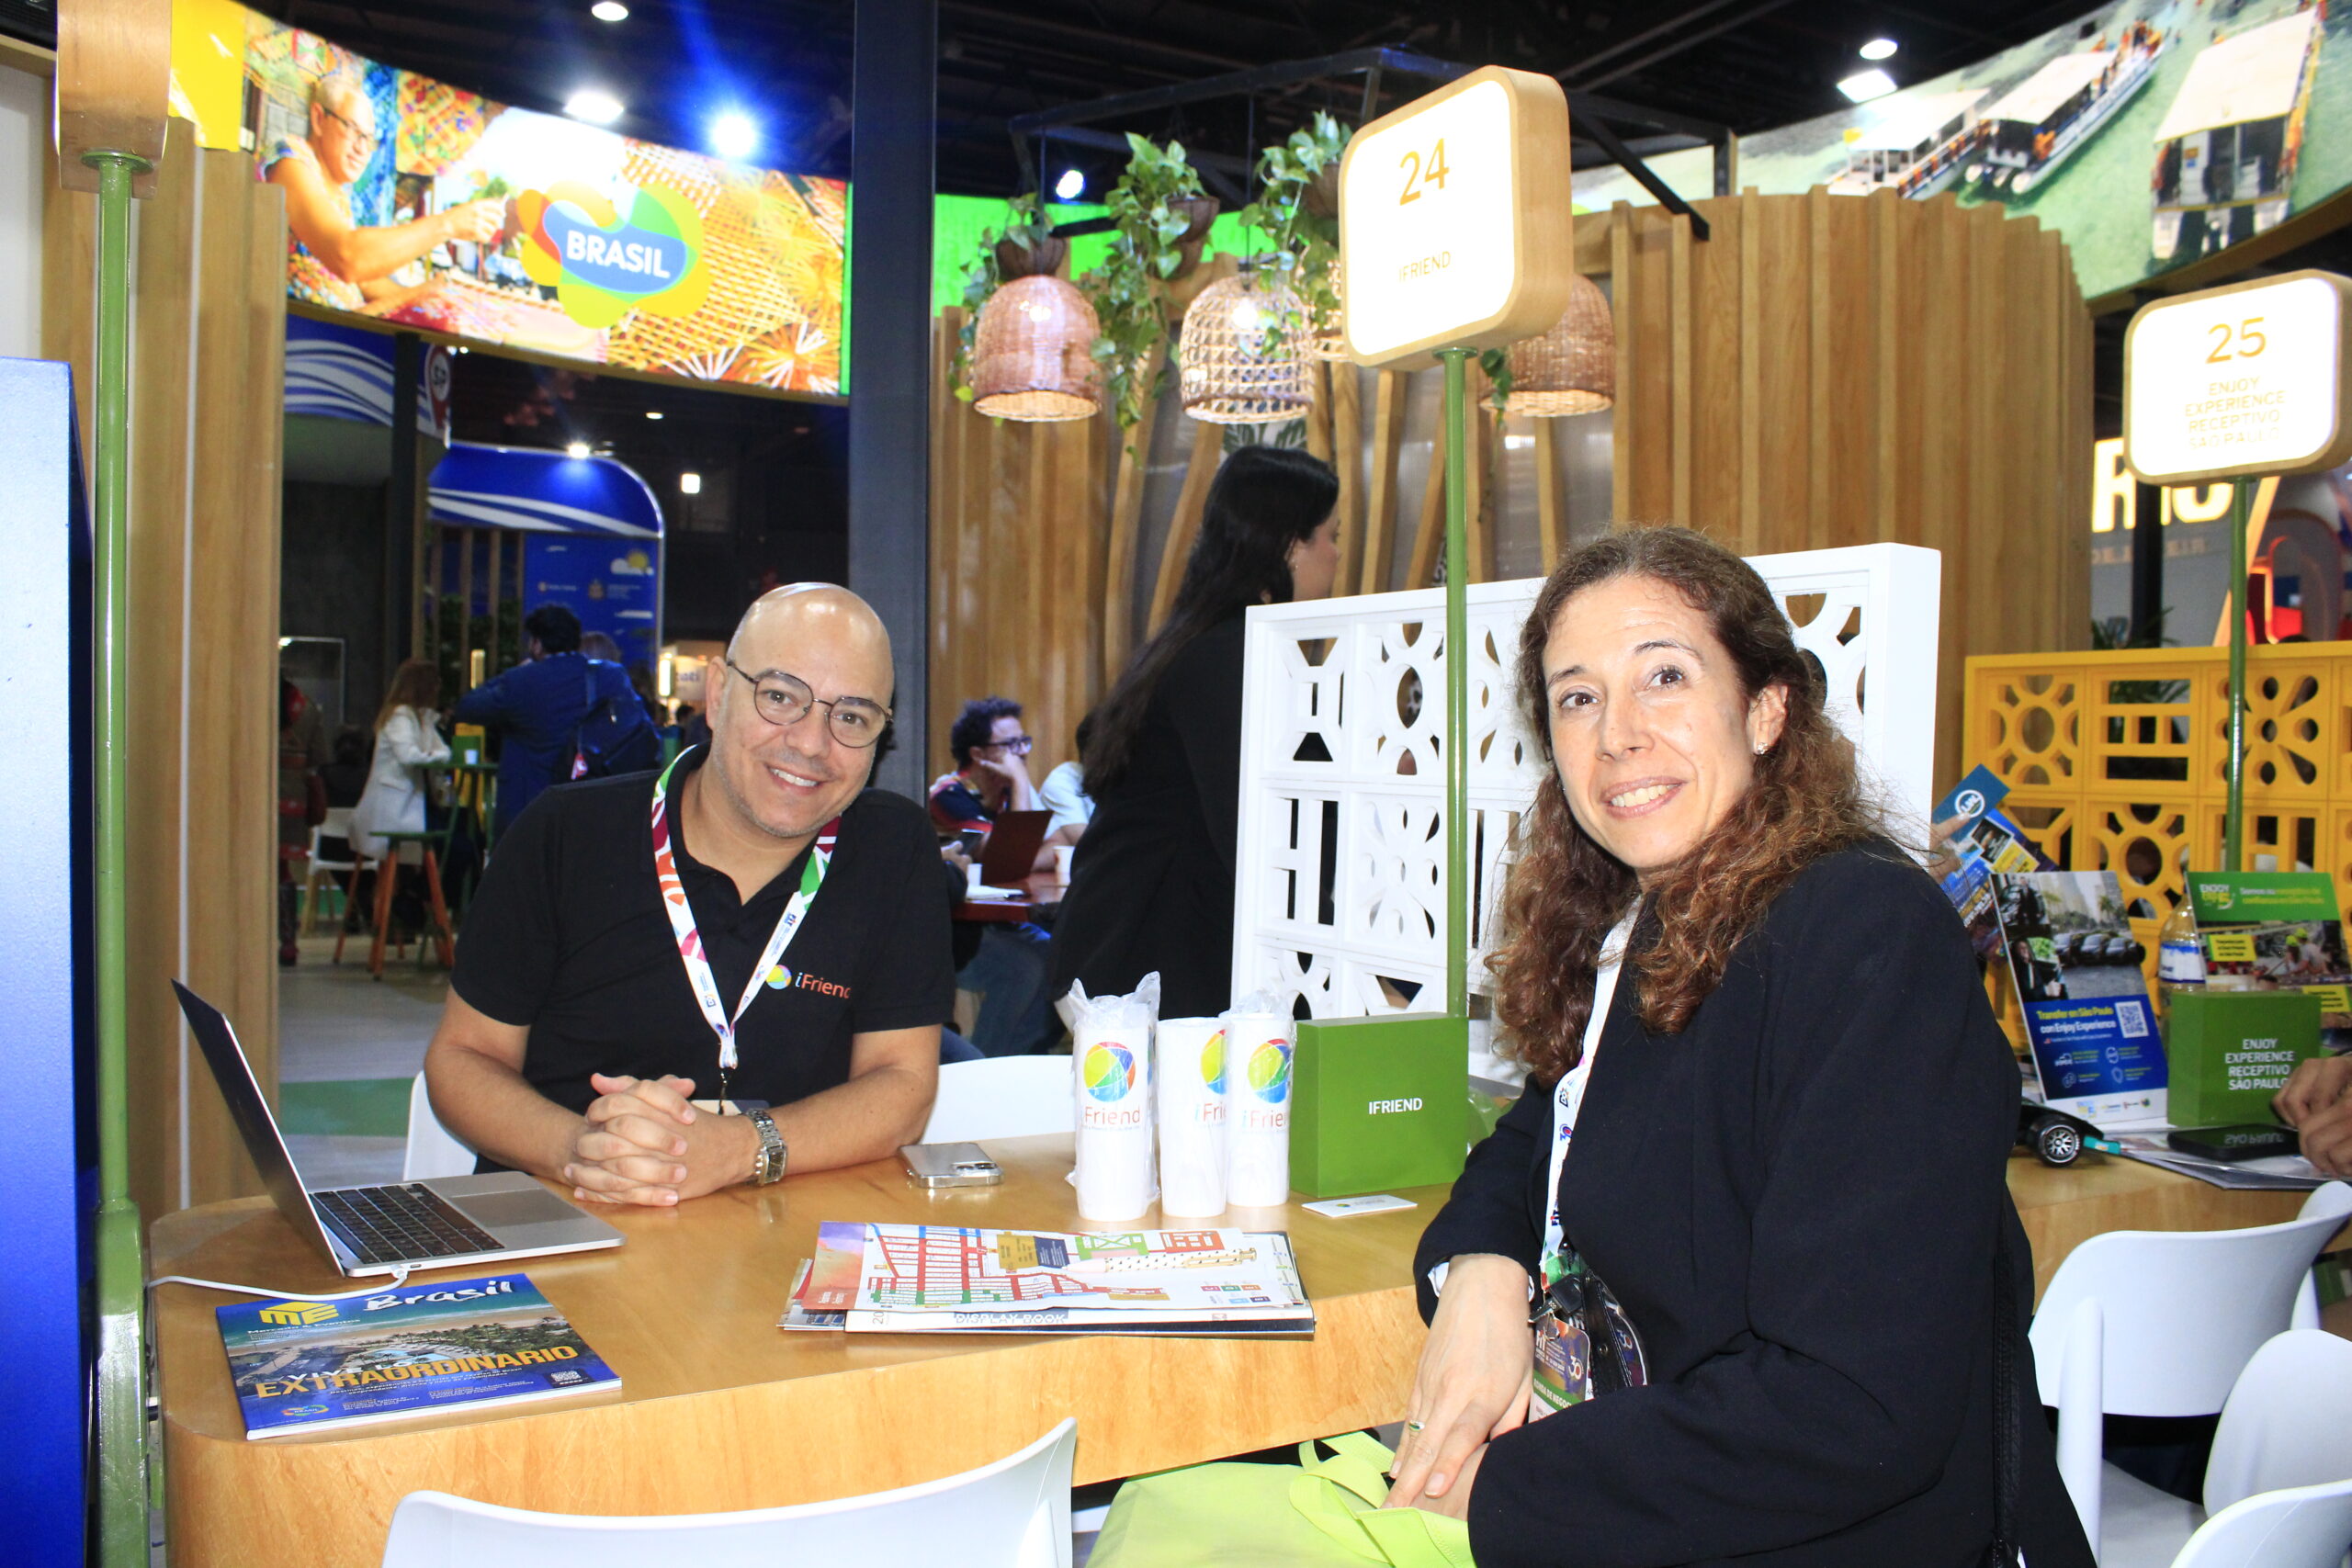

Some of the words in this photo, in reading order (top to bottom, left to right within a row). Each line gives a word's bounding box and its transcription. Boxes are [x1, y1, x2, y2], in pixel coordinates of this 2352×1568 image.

[1399, 138, 1450, 206] 24
[567, 230, 671, 278] BRASIL
[1399, 251, 1451, 283] IFRIEND
[2206, 317, 2267, 364] 25
[2209, 377, 2260, 396] ENJOY
[2185, 390, 2287, 417] EXPERIENCE
[2188, 410, 2280, 434] RECEPTIVO
[2224, 427, 2279, 446] PAULO
[2243, 1038, 2278, 1049] ENJOY
[2225, 1051, 2295, 1064] EXPERIENCE
[2228, 1065, 2290, 1077] RECEPTIVO
[1368, 1097, 1423, 1115] IFRIEND
[363, 1280, 514, 1311] Brasil
[956, 1313, 1018, 1324] DISPLAY
[1023, 1313, 1065, 1324] BOOK
[255, 1345, 580, 1399] EXTRAORDINARIO
[1568, 1356, 1582, 1380] 30
